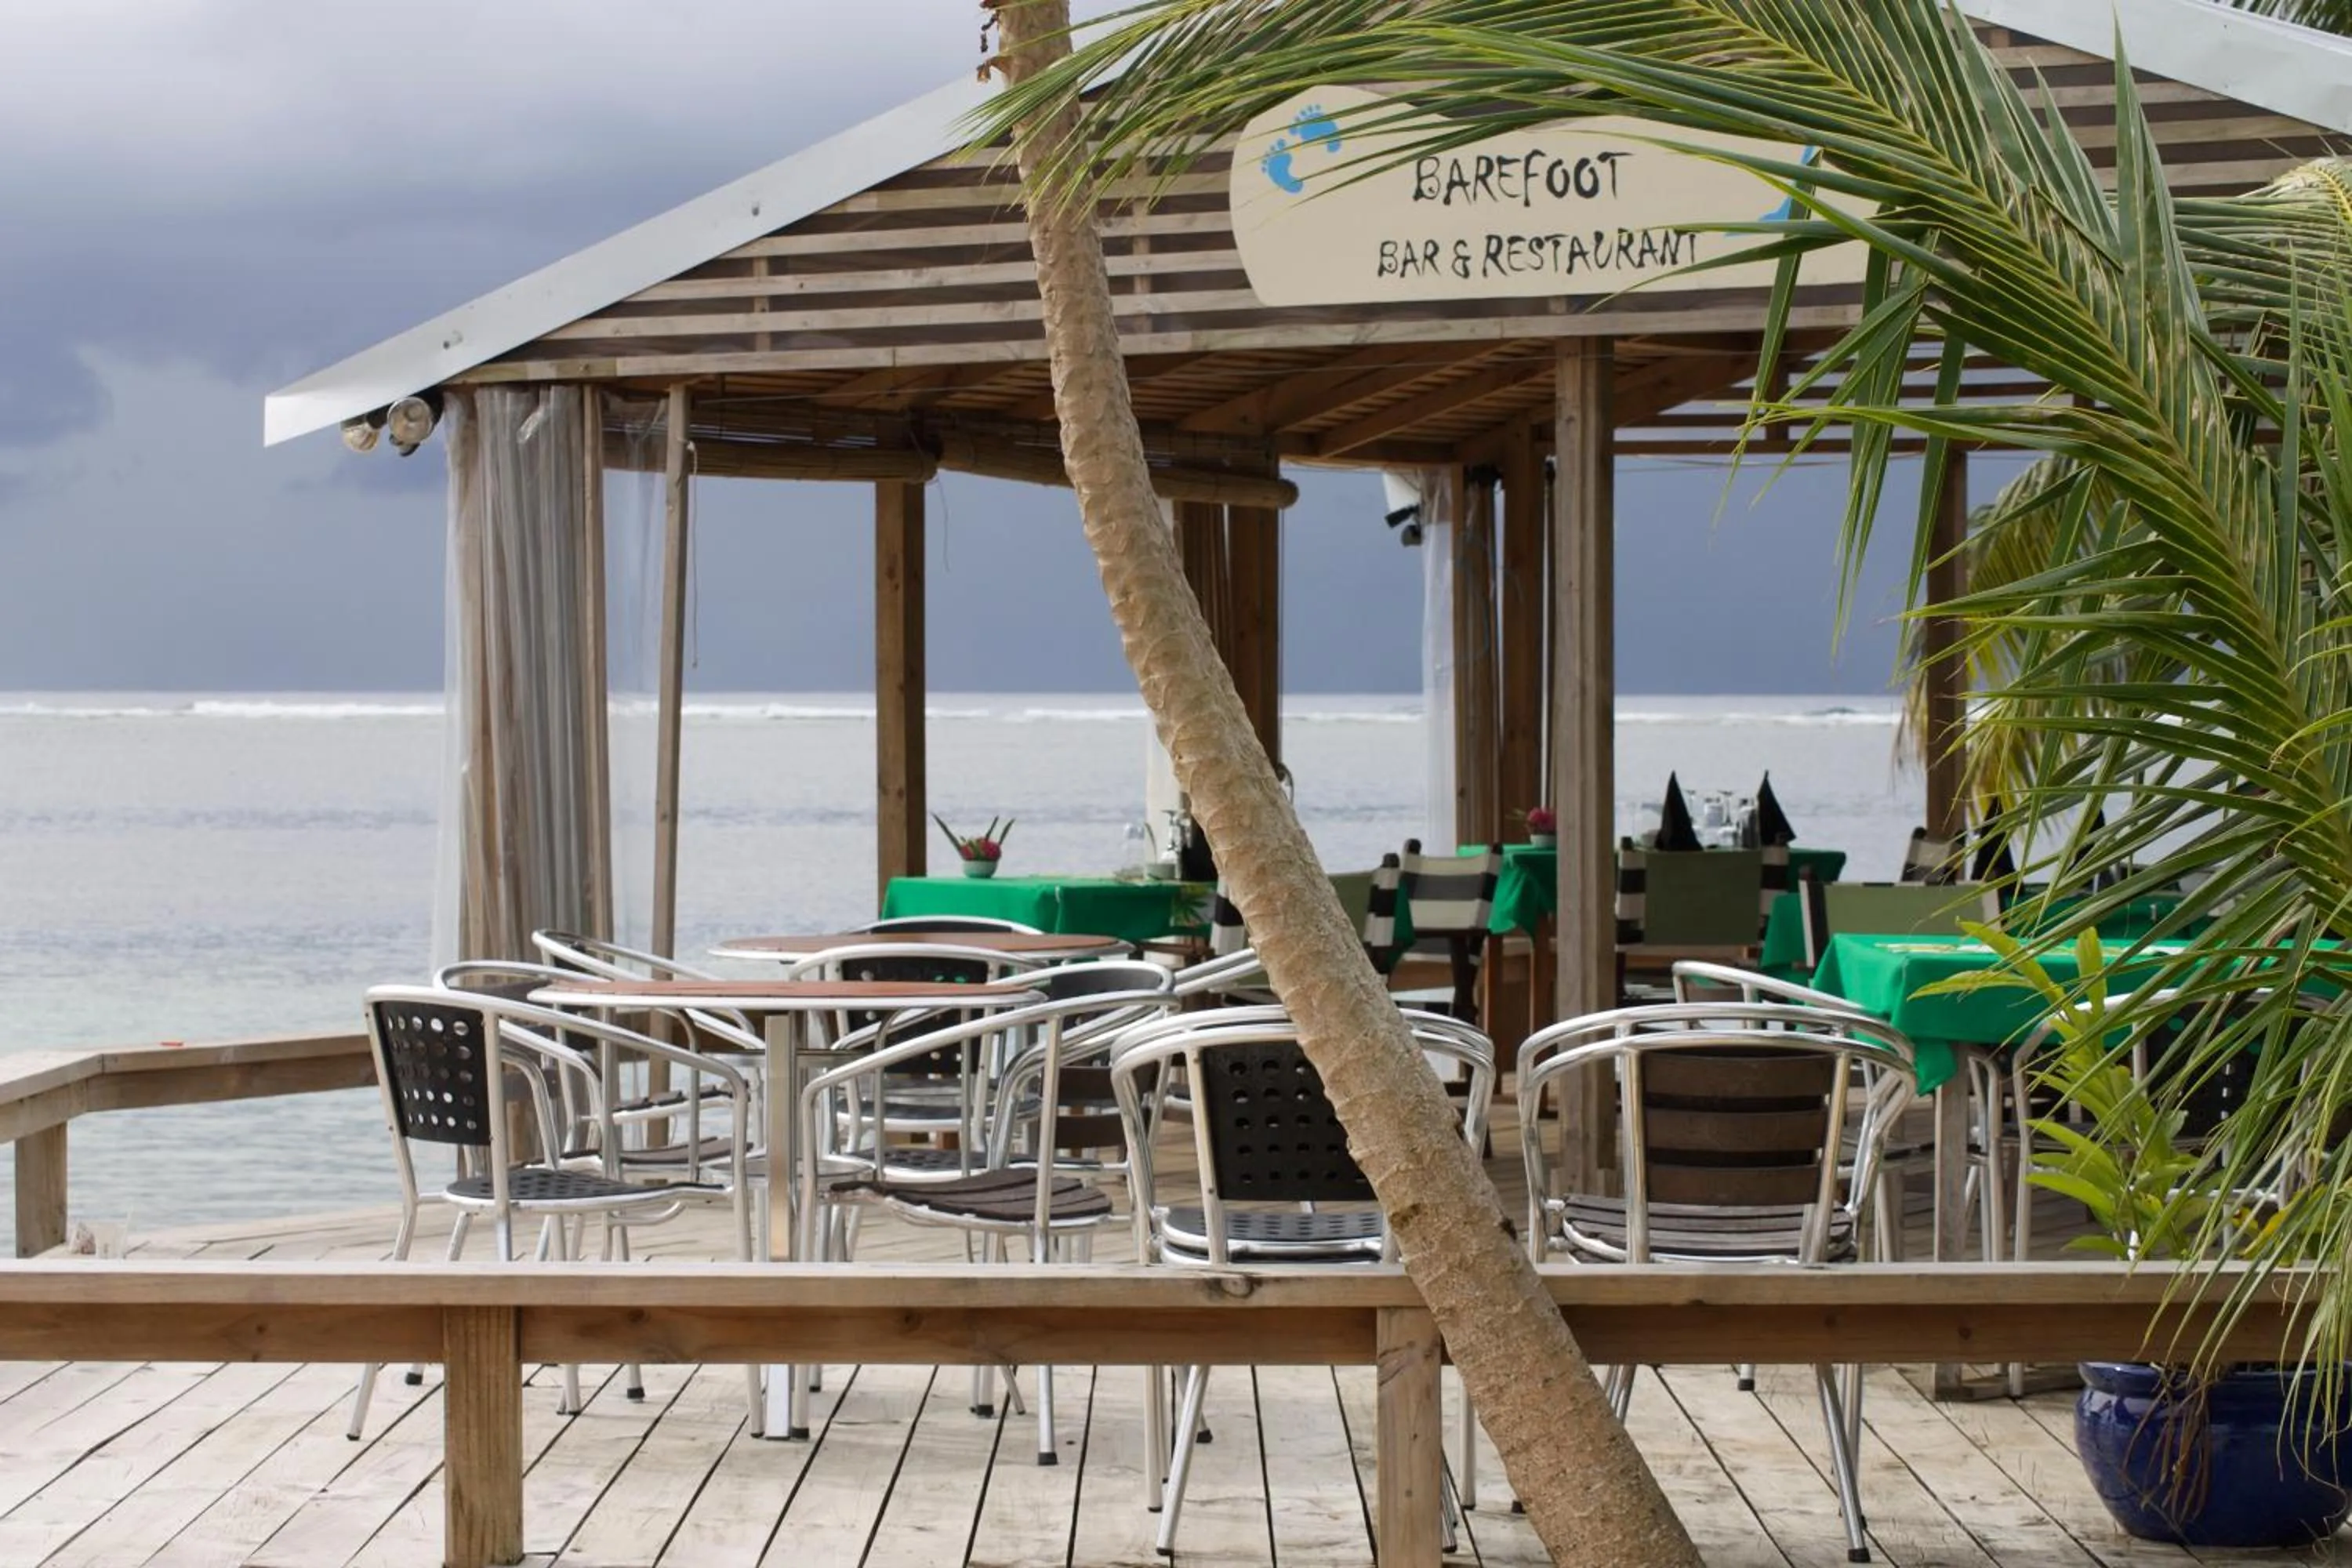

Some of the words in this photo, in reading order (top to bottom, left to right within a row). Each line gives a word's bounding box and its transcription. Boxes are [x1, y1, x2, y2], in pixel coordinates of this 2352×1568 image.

[1412, 149, 1635, 207] BAREFOOT
[1377, 240, 1441, 278] BAR
[1451, 239, 1472, 279] &
[1482, 227, 1698, 278] RESTAURANT
